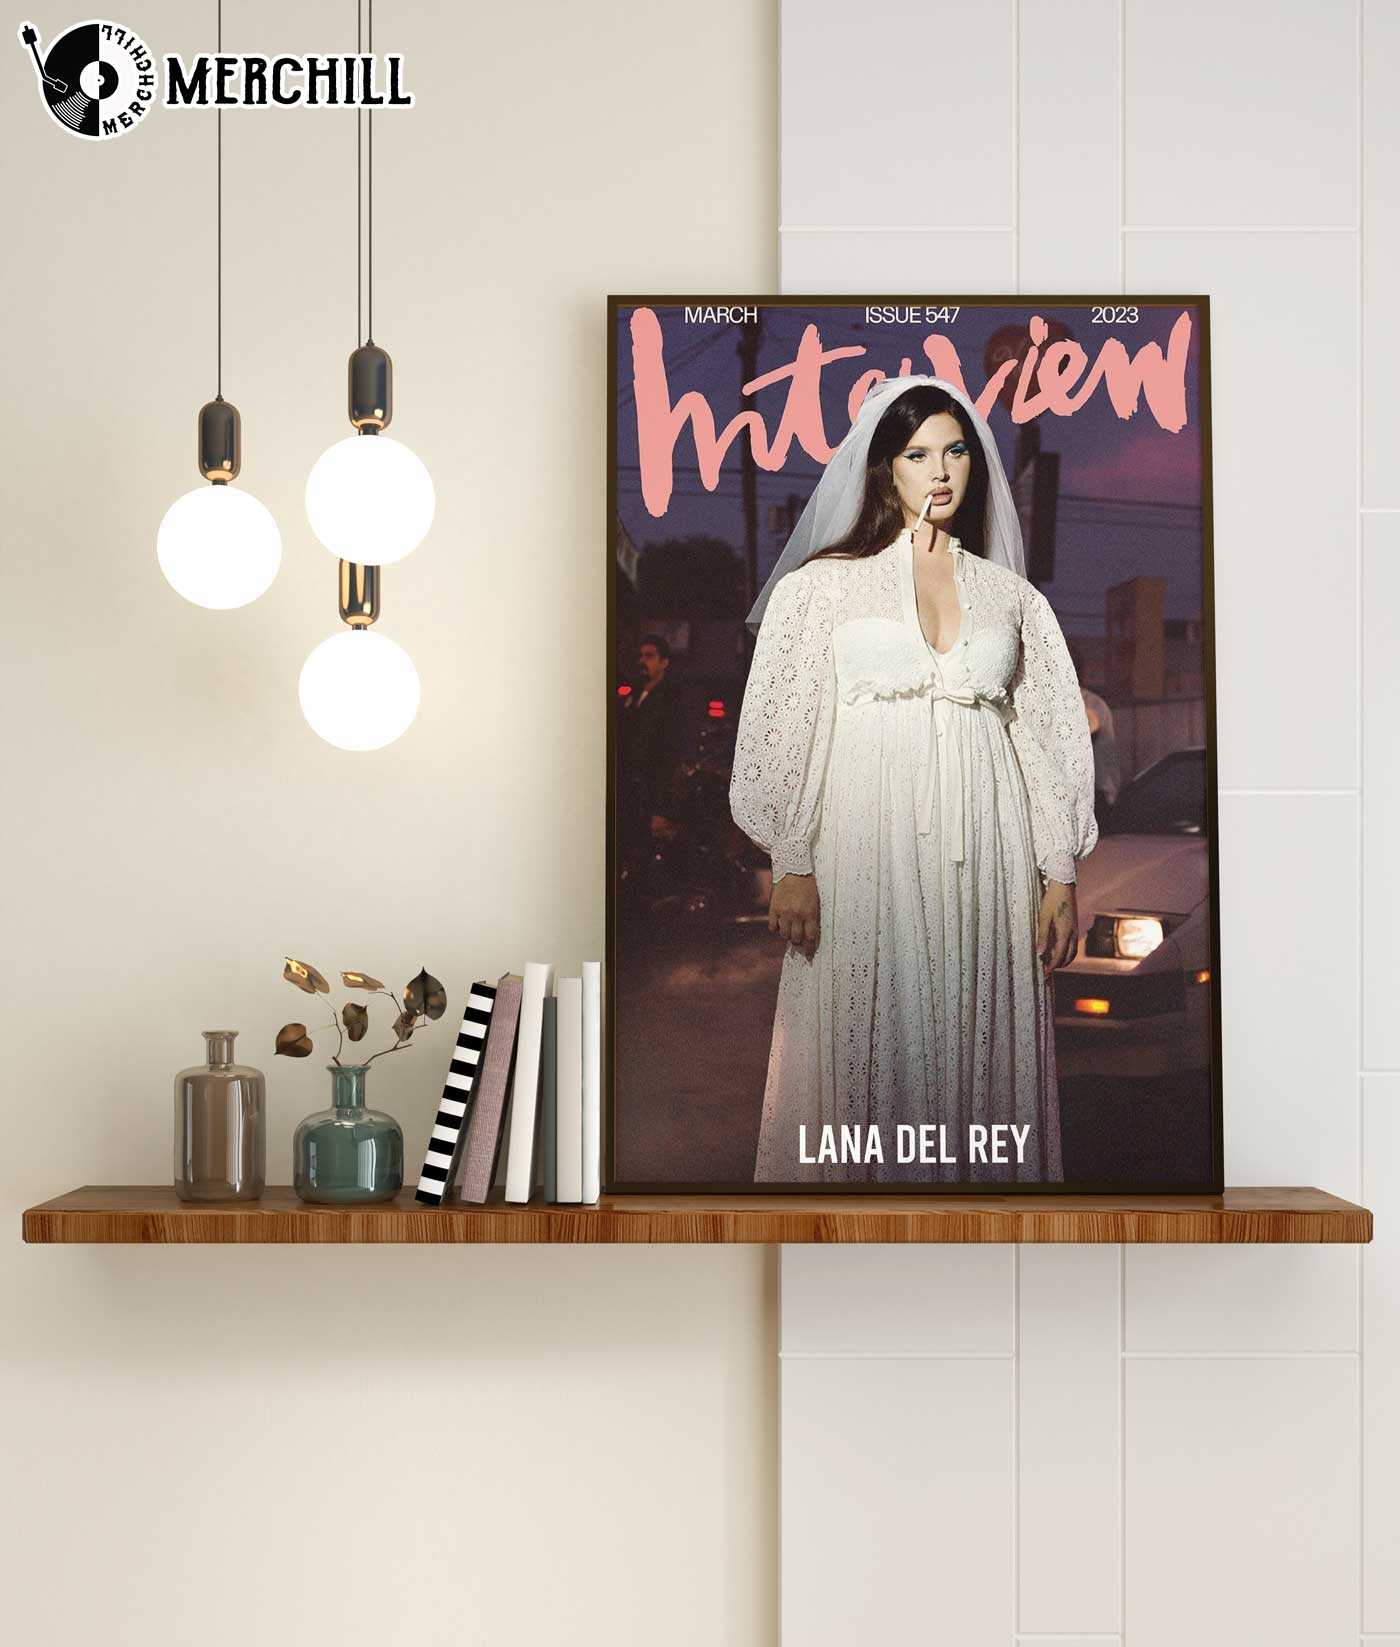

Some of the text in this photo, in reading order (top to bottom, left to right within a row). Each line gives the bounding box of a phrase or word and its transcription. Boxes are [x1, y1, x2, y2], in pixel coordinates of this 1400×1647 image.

[684, 306, 758, 324] MARCH
[865, 306, 960, 324] ISSUE 547
[1091, 306, 1139, 324] 2023
[630, 308, 1192, 518] Inteview
[799, 1124, 1031, 1164] LANA DEL REY
